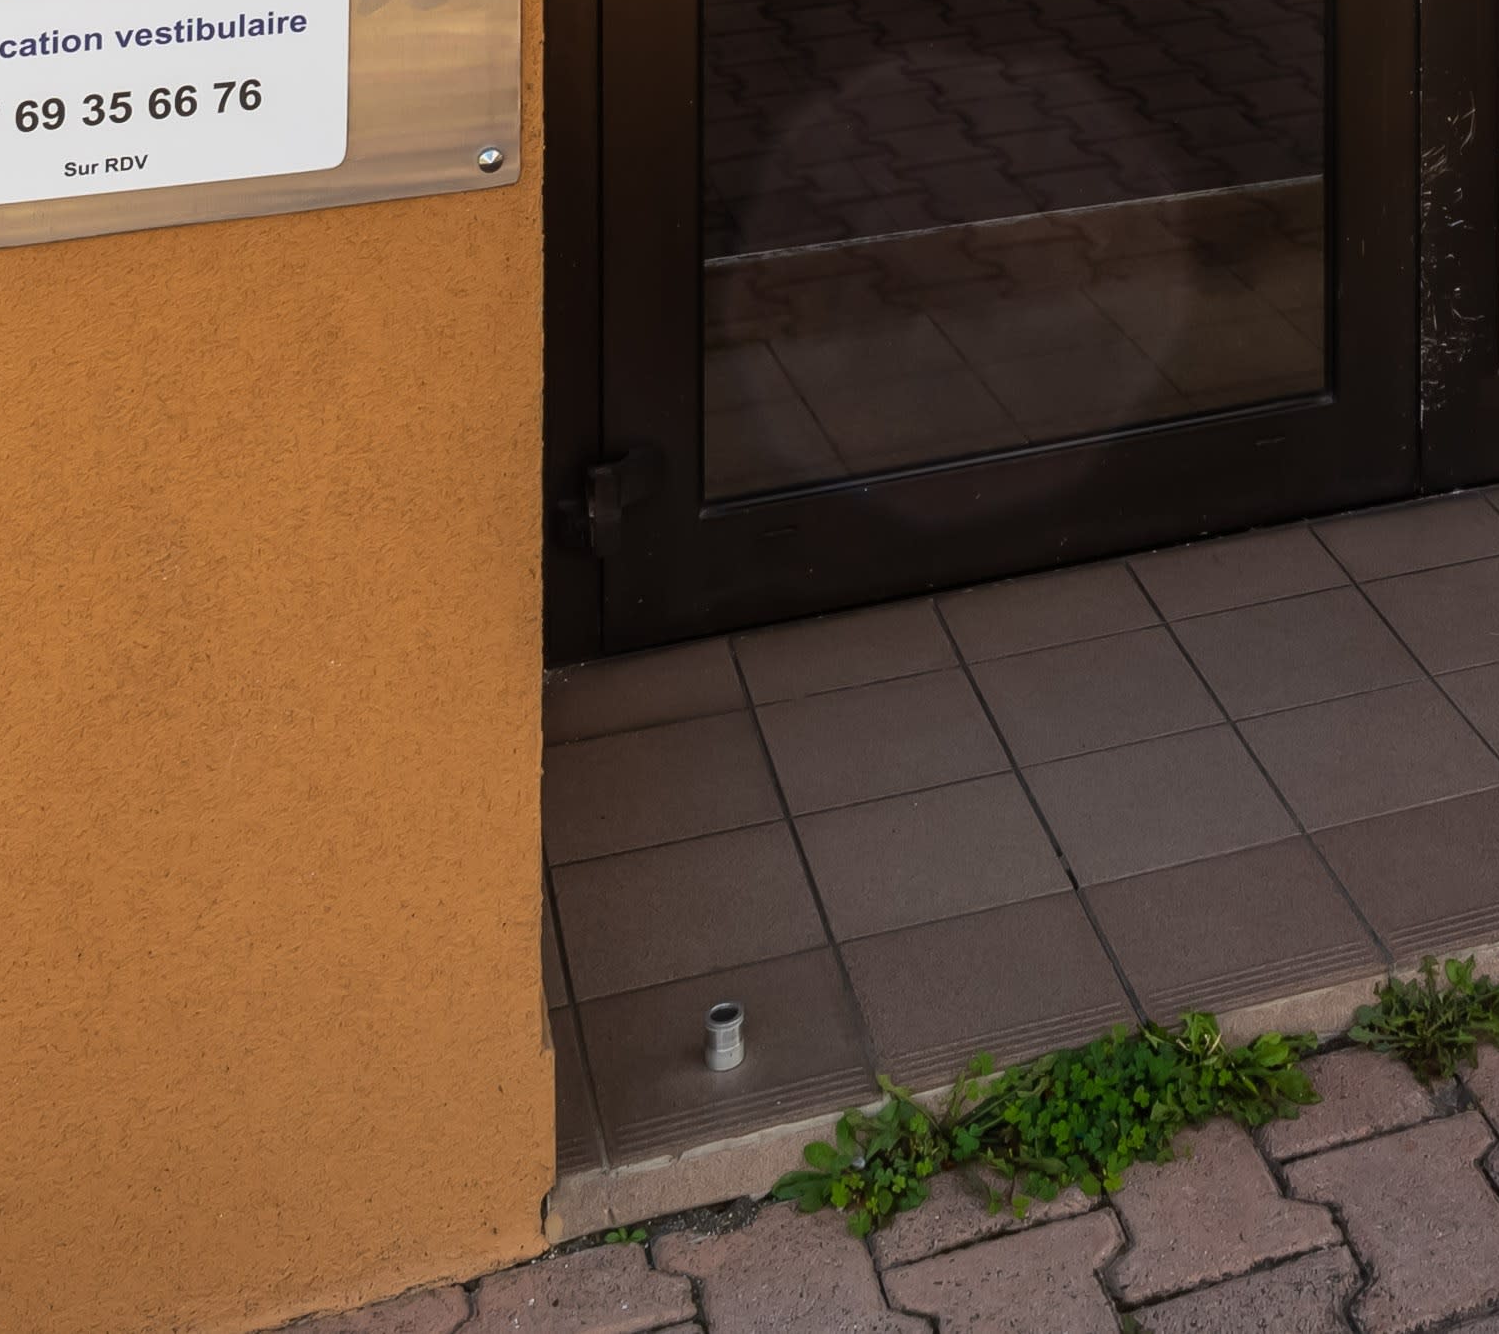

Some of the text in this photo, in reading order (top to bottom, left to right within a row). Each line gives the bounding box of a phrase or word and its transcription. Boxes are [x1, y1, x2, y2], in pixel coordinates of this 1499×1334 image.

[115, 12, 306, 47] vestibulaire
[16, 98, 65, 132] 69
[83, 91, 132, 126] 35
[149, 85, 197, 119] 66
[214, 79, 261, 113] 76
[64, 155, 148, 177] Sur RDV
